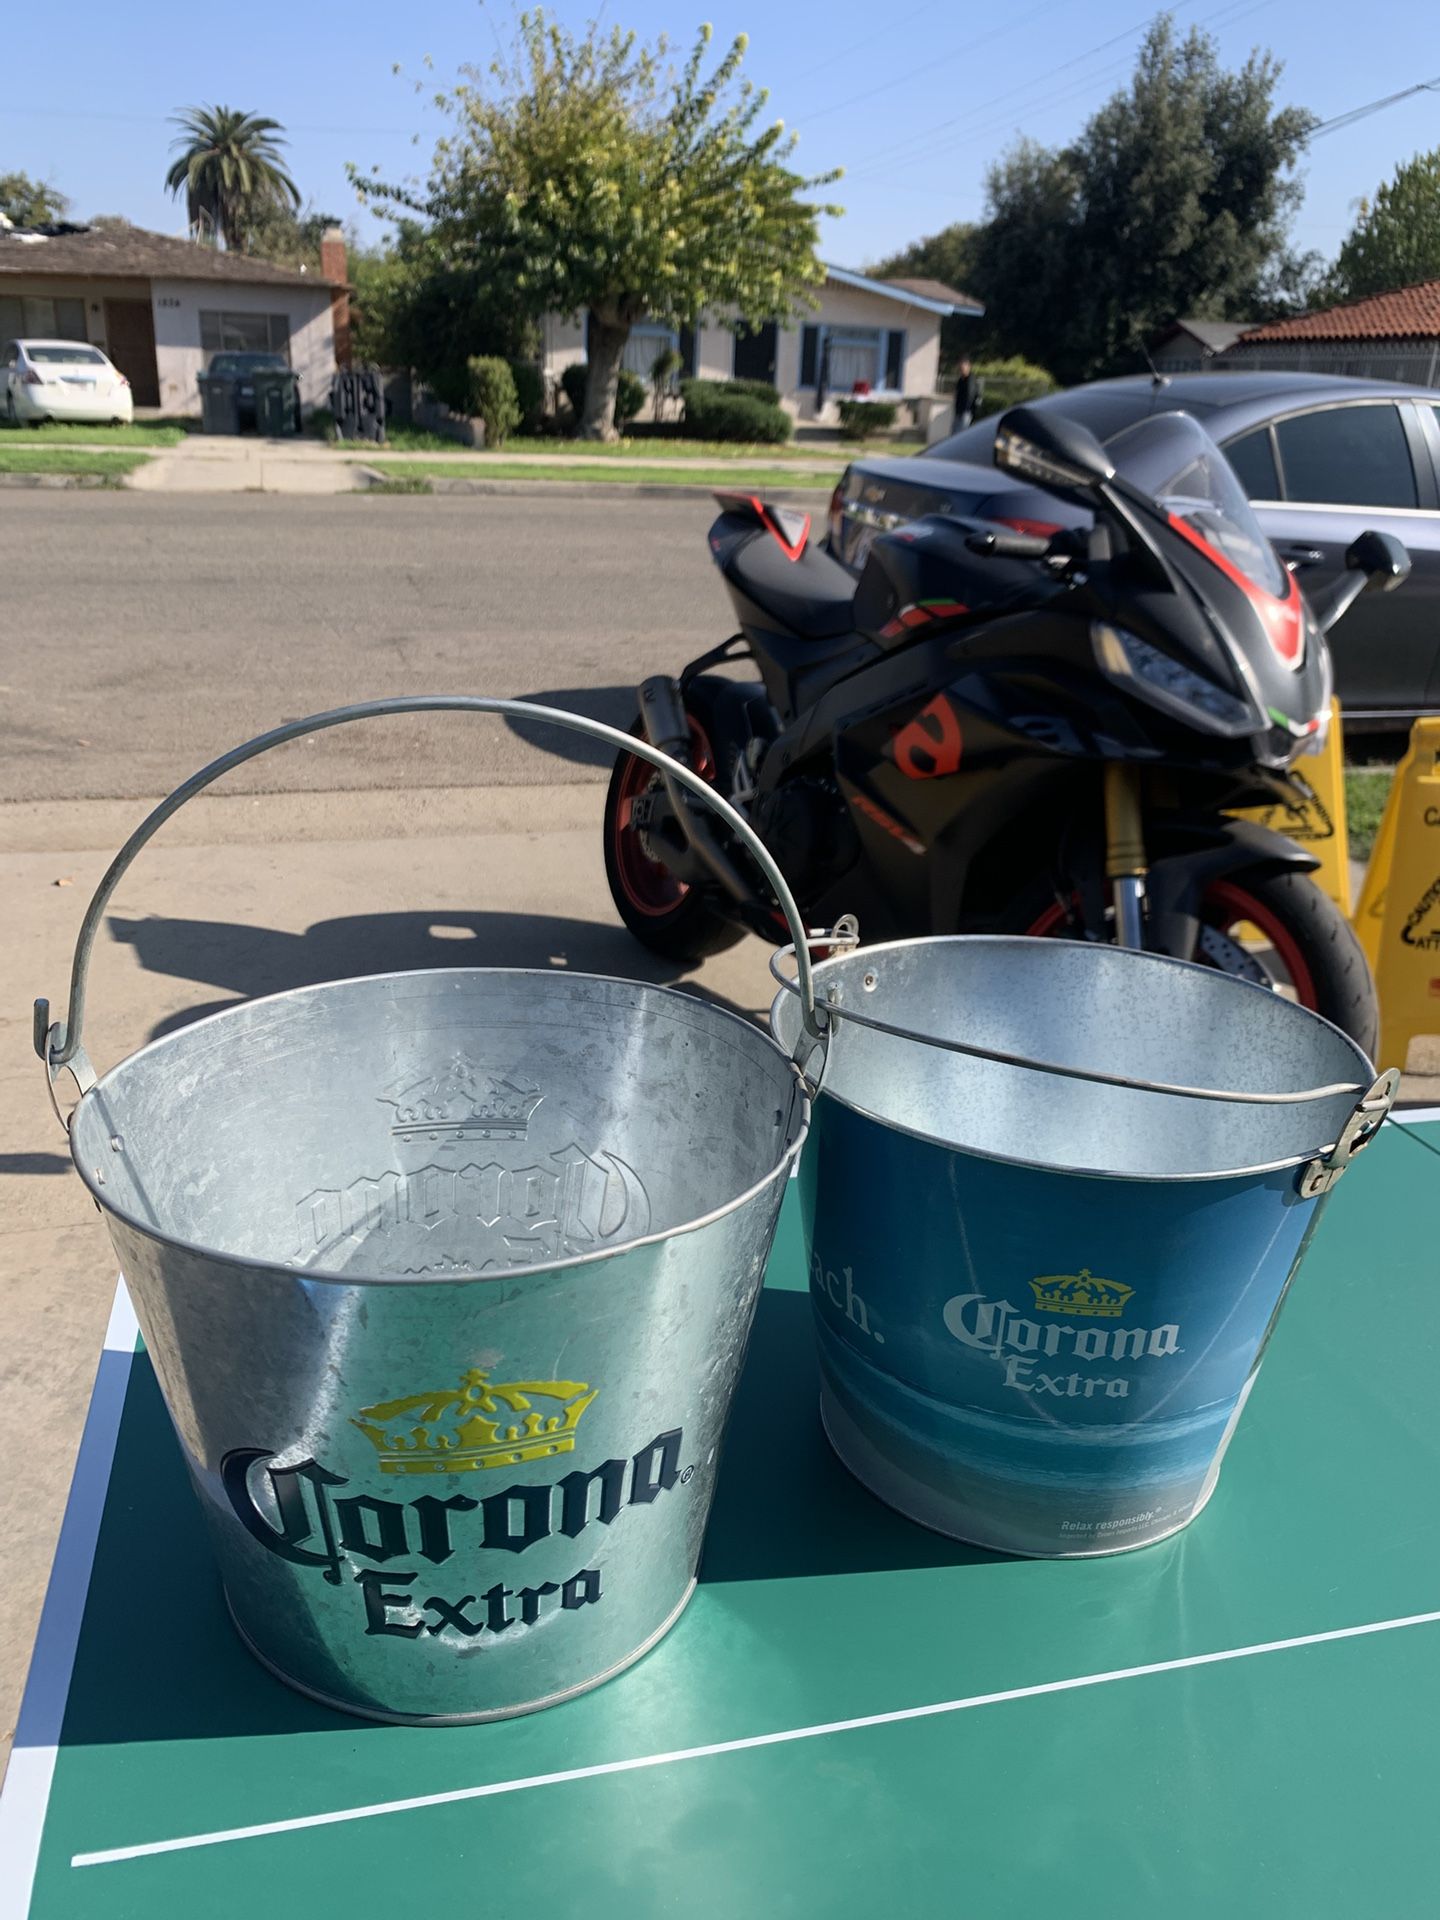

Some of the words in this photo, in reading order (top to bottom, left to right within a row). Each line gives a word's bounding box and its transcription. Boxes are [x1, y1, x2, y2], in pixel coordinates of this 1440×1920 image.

[811, 1251, 885, 1344] ach.
[943, 1293, 1181, 1361] Corona
[1002, 1355, 1129, 1399] Extra
[219, 1426, 684, 1585] Corona
[1061, 1520, 1093, 1531] Relax
[354, 1568, 603, 1639] Extra
